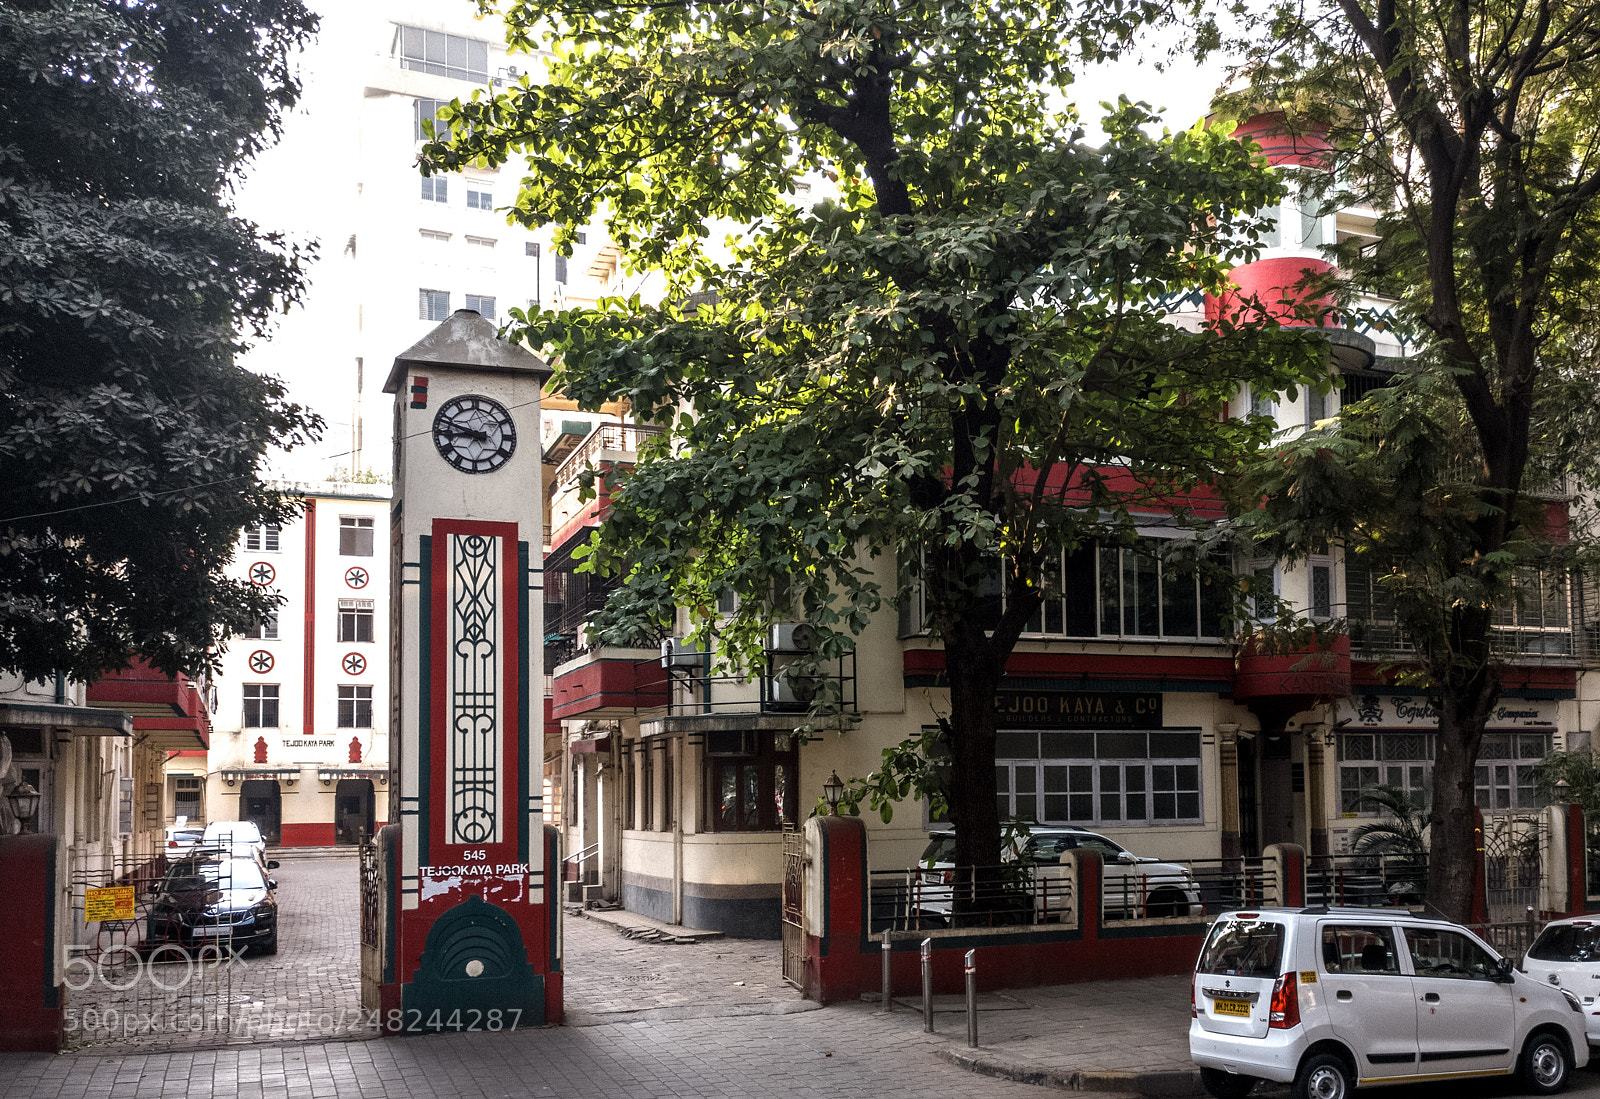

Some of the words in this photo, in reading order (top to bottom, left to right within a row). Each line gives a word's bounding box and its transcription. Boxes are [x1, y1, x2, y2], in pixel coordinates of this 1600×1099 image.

[994, 695, 1048, 713] EJOO
[1059, 696, 1105, 714] KAYA
[1114, 699, 1125, 714] &
[1067, 715, 1133, 723] CONTRACTORS
[463, 850, 486, 860] 545
[419, 865, 493, 877] TEJOOKAYA
[496, 863, 529, 874] PARK
